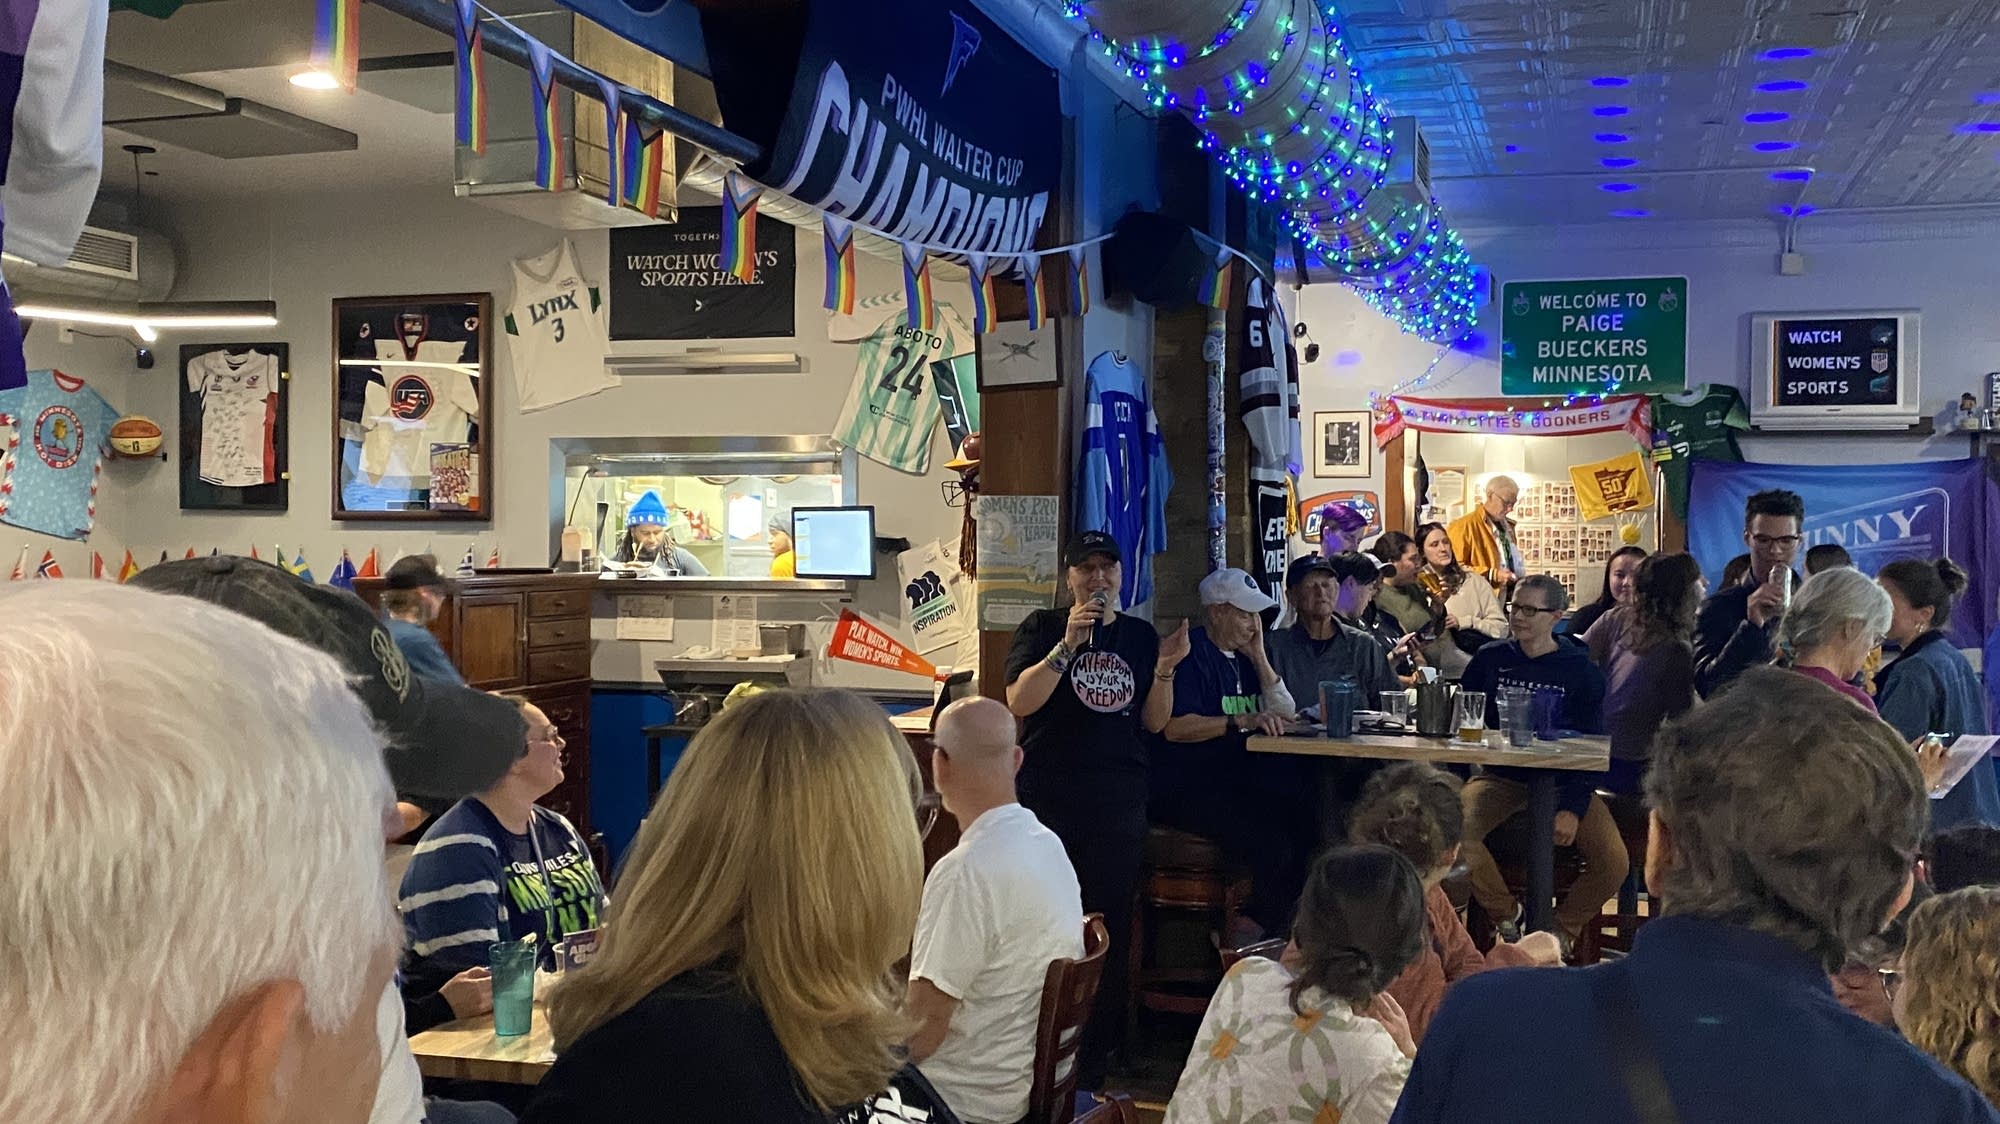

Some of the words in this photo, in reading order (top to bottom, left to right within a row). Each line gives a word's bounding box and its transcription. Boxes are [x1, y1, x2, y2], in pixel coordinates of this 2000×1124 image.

[880, 73, 928, 147] PWHL
[932, 121, 992, 185] WALTER
[996, 156, 1024, 187] CUP
[780, 60, 1049, 272] CHAMPIONS
[627, 254, 688, 271] WATCH
[692, 250, 778, 269] WON'S
[640, 270, 708, 287] SPORTS
[527, 289, 579, 326] LYNX
[1539, 292, 1621, 310] WELCOME
[1626, 292, 1647, 308] TO
[551, 317, 565, 343] 3
[1562, 314, 1624, 333] PAIGE
[894, 325, 943, 350] ABOTO
[1788, 330, 1842, 345] WATCH
[1538, 338, 1648, 359] BUECKERS
[879, 345, 928, 401] 24
[1532, 364, 1652, 383] MINNESOTA
[1787, 356, 1861, 370] WOMEN'S
[1787, 380, 1849, 395] SPORTS
[1531, 410, 1611, 429] GOONERS
[1030, 496, 1057, 515] PRO
[912, 602, 957, 635] INSPIRATION
[842, 638, 874, 661] WOMEN'S
[1073, 654, 1093, 678] MY
[1094, 653, 1132, 681] FREEDOM
[1086, 674, 1095, 685] IS
[1096, 672, 1120, 686] YOUR
[1077, 679, 1132, 707] FREEDOM
